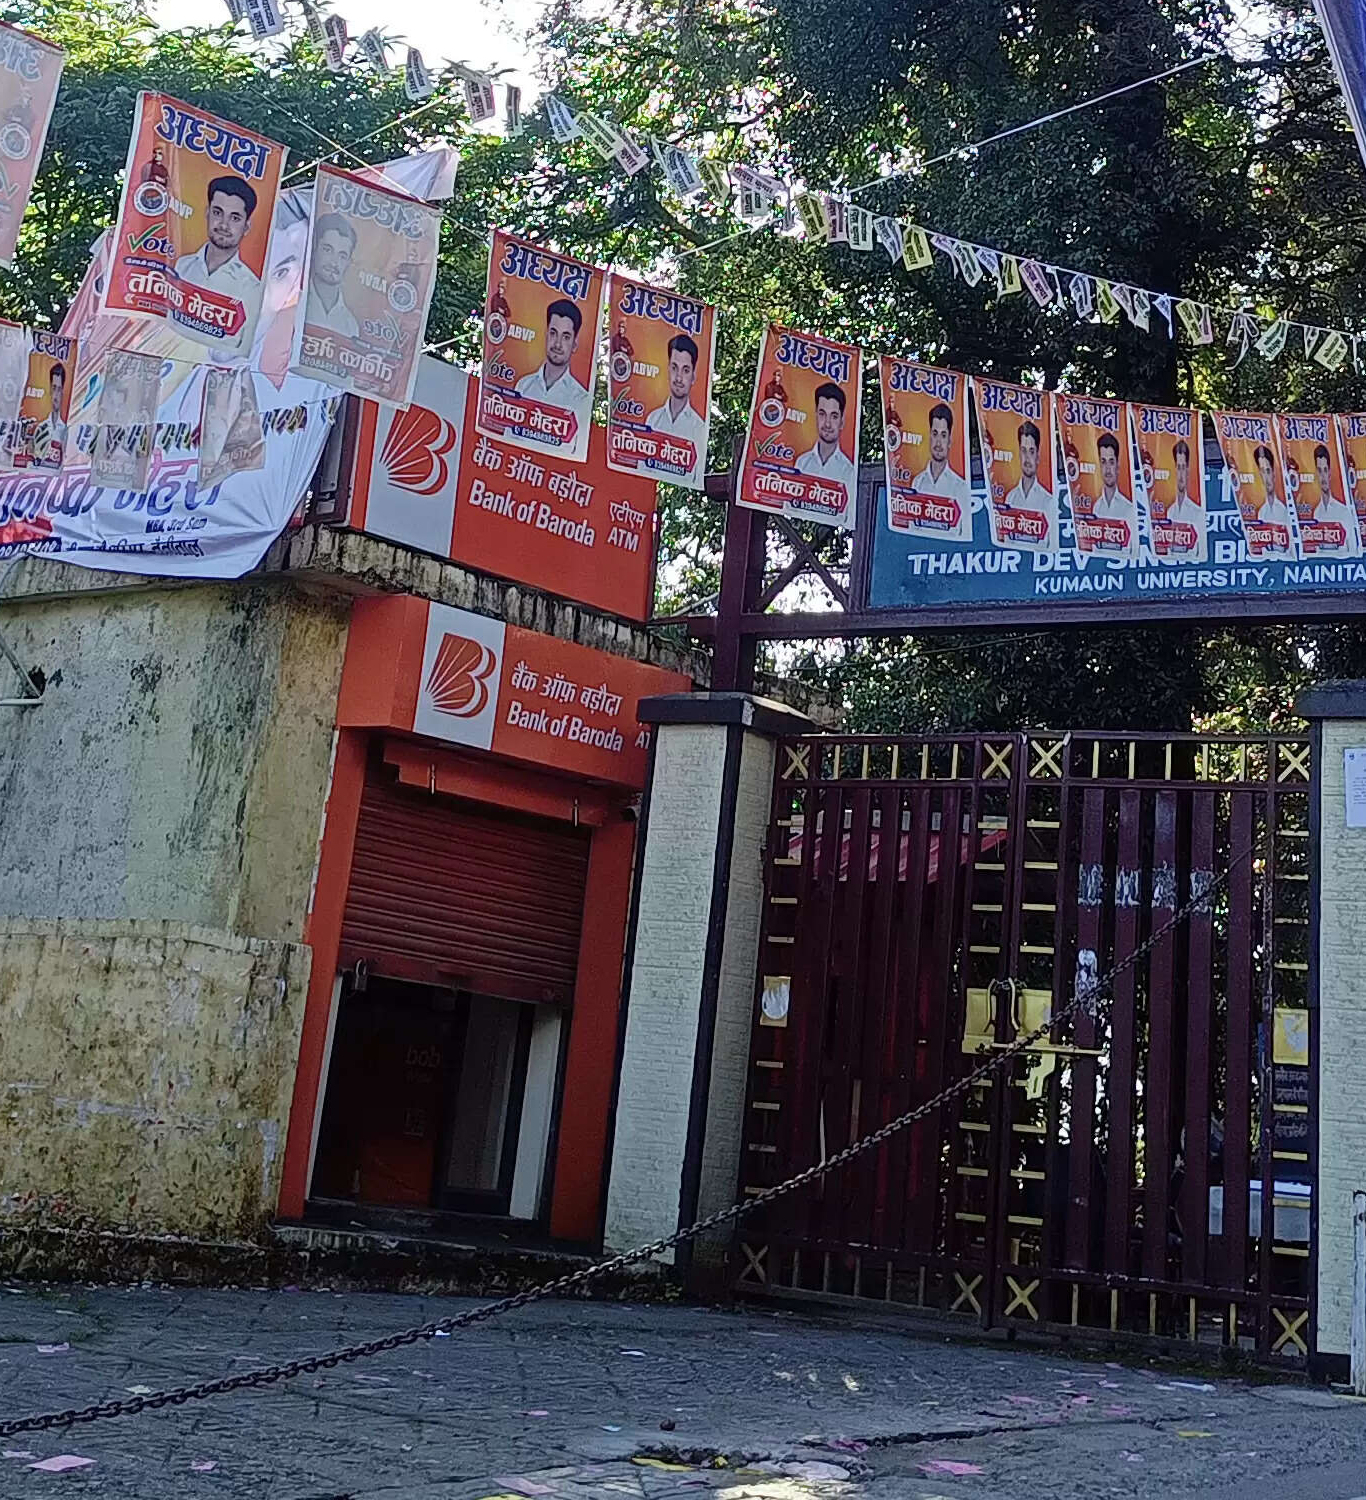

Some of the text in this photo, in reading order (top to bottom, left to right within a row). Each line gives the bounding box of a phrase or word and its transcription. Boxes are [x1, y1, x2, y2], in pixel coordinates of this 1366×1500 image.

[155, 104, 271, 181] अध्यक्ष
[500, 240, 595, 300] अध्यक्ष
[187, 288, 238, 332] मेहरा
[619, 282, 705, 335] अध्यक्ष
[508, 323, 535, 342] ABVP
[633, 361, 660, 378] ABVP
[776, 333, 851, 383] अध्यक्ष
[889, 362, 958, 402] अध्यक्ष
[981, 382, 1042, 421] अध्यक्ष
[483, 393, 571, 438] तनिष्क मेहरा
[1063, 399, 1119, 432] अध्यक्ष
[611, 428, 693, 468] तनिष्क मेहरा
[473, 436, 502, 471] बैंक
[548, 470, 594, 507] बड़ौदा
[754, 469, 844, 507] तनिष्क मेहरा
[469, 479, 596, 547] Bank of Baroda
[609, 501, 646, 529] एटीएम
[607, 527, 639, 552] ATM
[907, 550, 1022, 575] THAKUR
[1032, 548, 1090, 572] DEV
[1035, 574, 1123, 594] KUMAUN
[1138, 567, 1276, 589] UNIVERSITY,
[511, 660, 539, 692] बैंक
[580, 683, 623, 716] बड़ौदा
[507, 700, 623, 752] Bank of Baroda
[635, 731, 650, 749] AT
